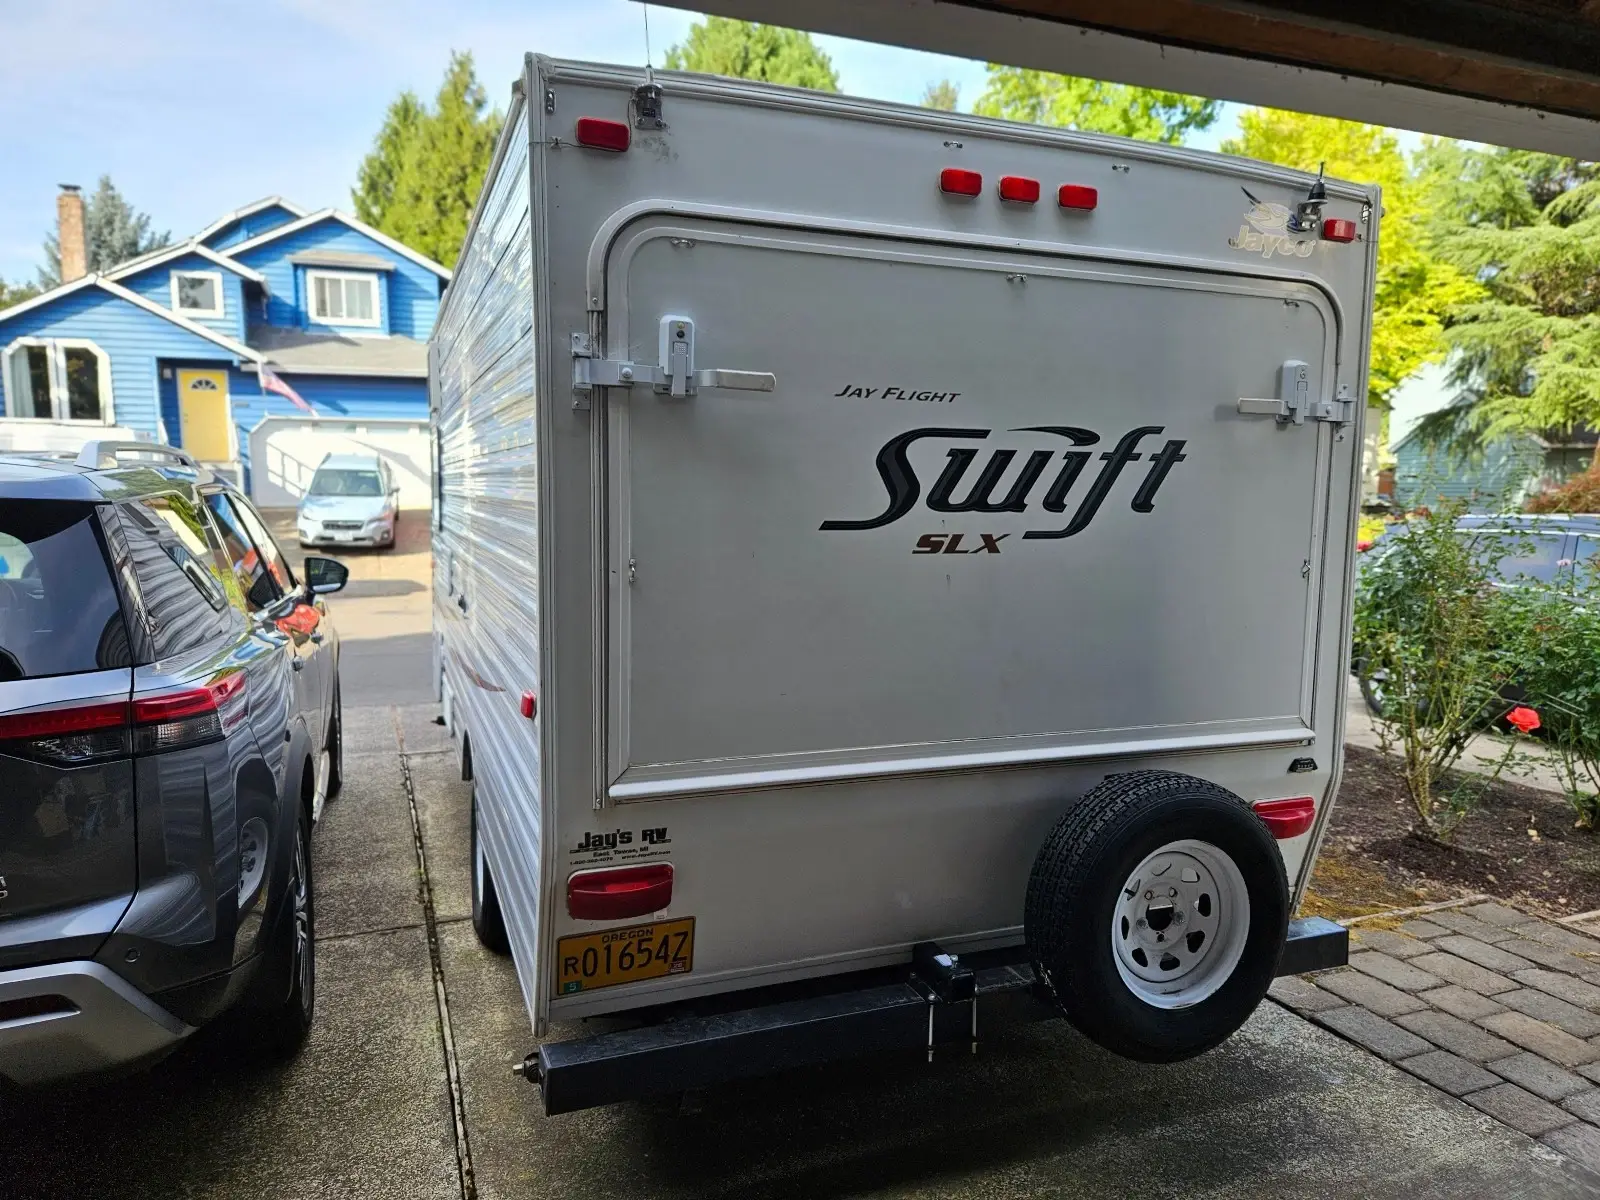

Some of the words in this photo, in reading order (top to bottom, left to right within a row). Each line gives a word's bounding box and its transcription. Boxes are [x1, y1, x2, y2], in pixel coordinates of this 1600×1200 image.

[834, 384, 879, 399] JAY
[881, 387, 962, 403] FLIGHT
[818, 426, 1188, 539] Swift
[911, 533, 1011, 554] SLX
[577, 829, 633, 850] Jay's
[641, 827, 669, 844] RV
[602, 928, 654, 944] OREGON
[563, 931, 689, 978] R01654Z
